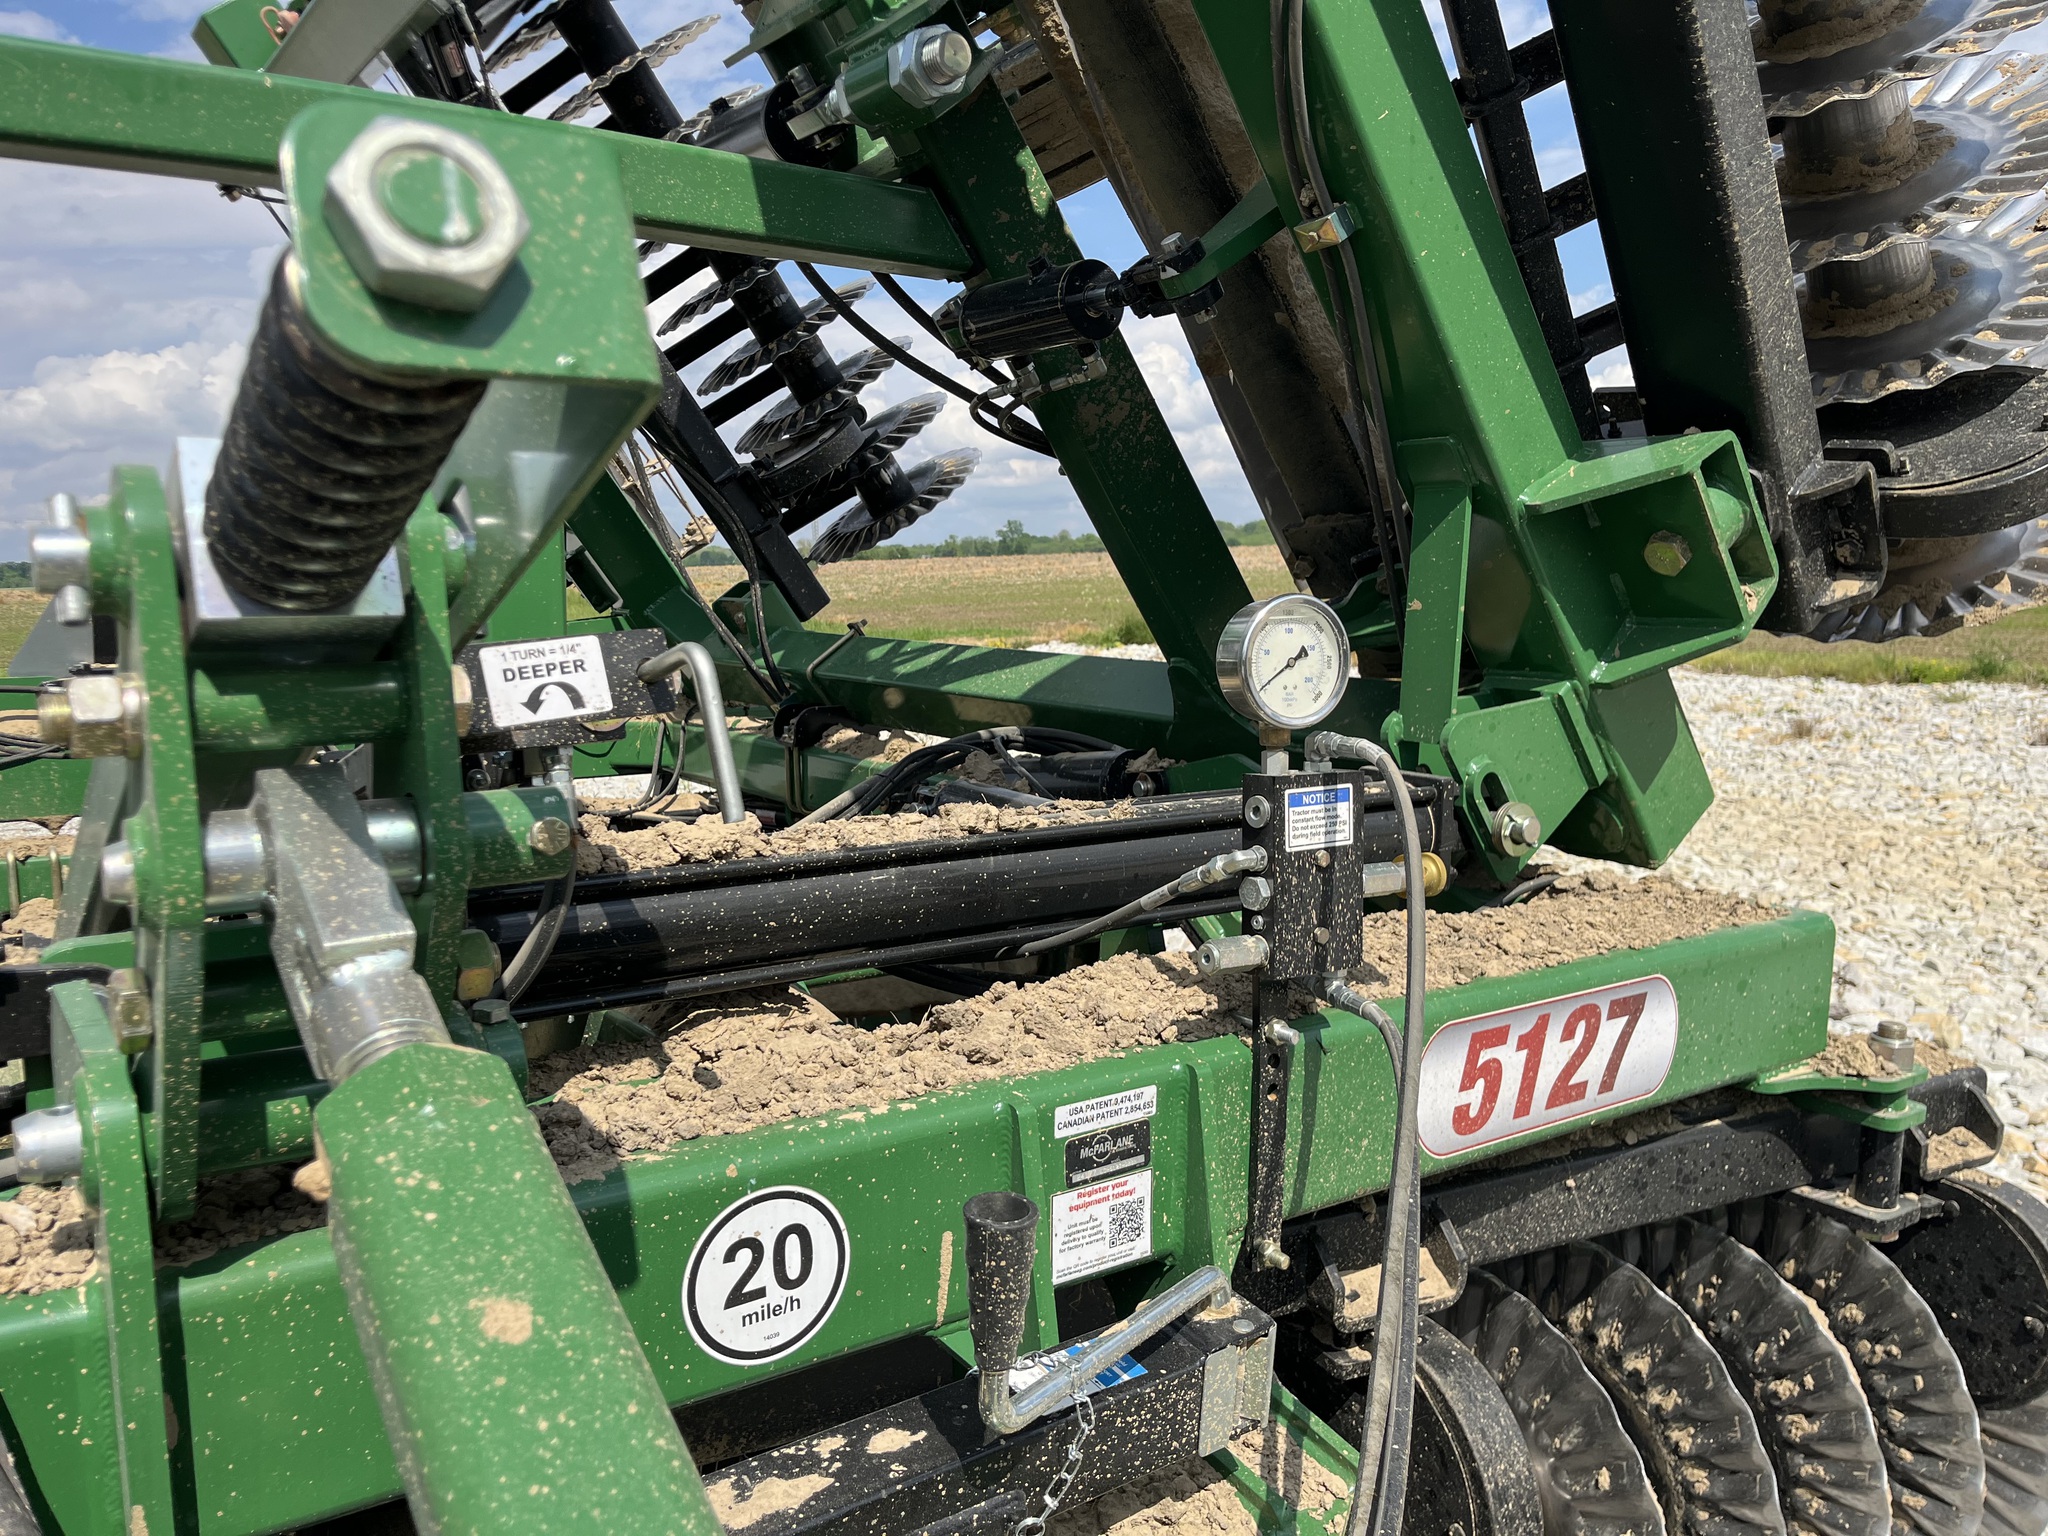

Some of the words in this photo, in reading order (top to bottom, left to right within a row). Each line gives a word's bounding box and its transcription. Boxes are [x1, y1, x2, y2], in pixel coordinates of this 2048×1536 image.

[1313, 621, 1324, 634] 2000
[501, 653, 508, 662] 1
[512, 647, 546, 662] TURN
[560, 643, 581, 655] 1/4"
[503, 659, 588, 683] DEEPER
[1312, 691, 1323, 704] 3000
[1302, 792, 1336, 805] NOTICE
[1322, 828, 1346, 836] operation.
[1452, 991, 1648, 1136] 5127
[1069, 1106, 1084, 1117] USA
[1086, 1099, 1113, 1112] PATENT
[1114, 1091, 1144, 1106] 9,474,197
[1057, 1115, 1095, 1130] CANADIAN
[1096, 1109, 1123, 1122] PATENT
[1124, 1101, 1154, 1115] 2,854,653
[1080, 1134, 1134, 1159] McFARLANE
[1077, 1184, 1110, 1199] Register
[1112, 1179, 1129, 1191] your
[1069, 1196, 1110, 1212] equipment
[1112, 1187, 1136, 1200] today!
[1061, 1236, 1081, 1246] delivery
[1087, 1230, 1105, 1239] qualify
[1063, 1226, 1088, 1238] registered
[1089, 1222, 1102, 1232] upon
[1067, 1241, 1084, 1252] factory
[1085, 1236, 1107, 1246] warranty
[722, 1222, 814, 1311] 20
[741, 1295, 801, 1328] mile/h
[763, 1331, 780, 1341] 14039
